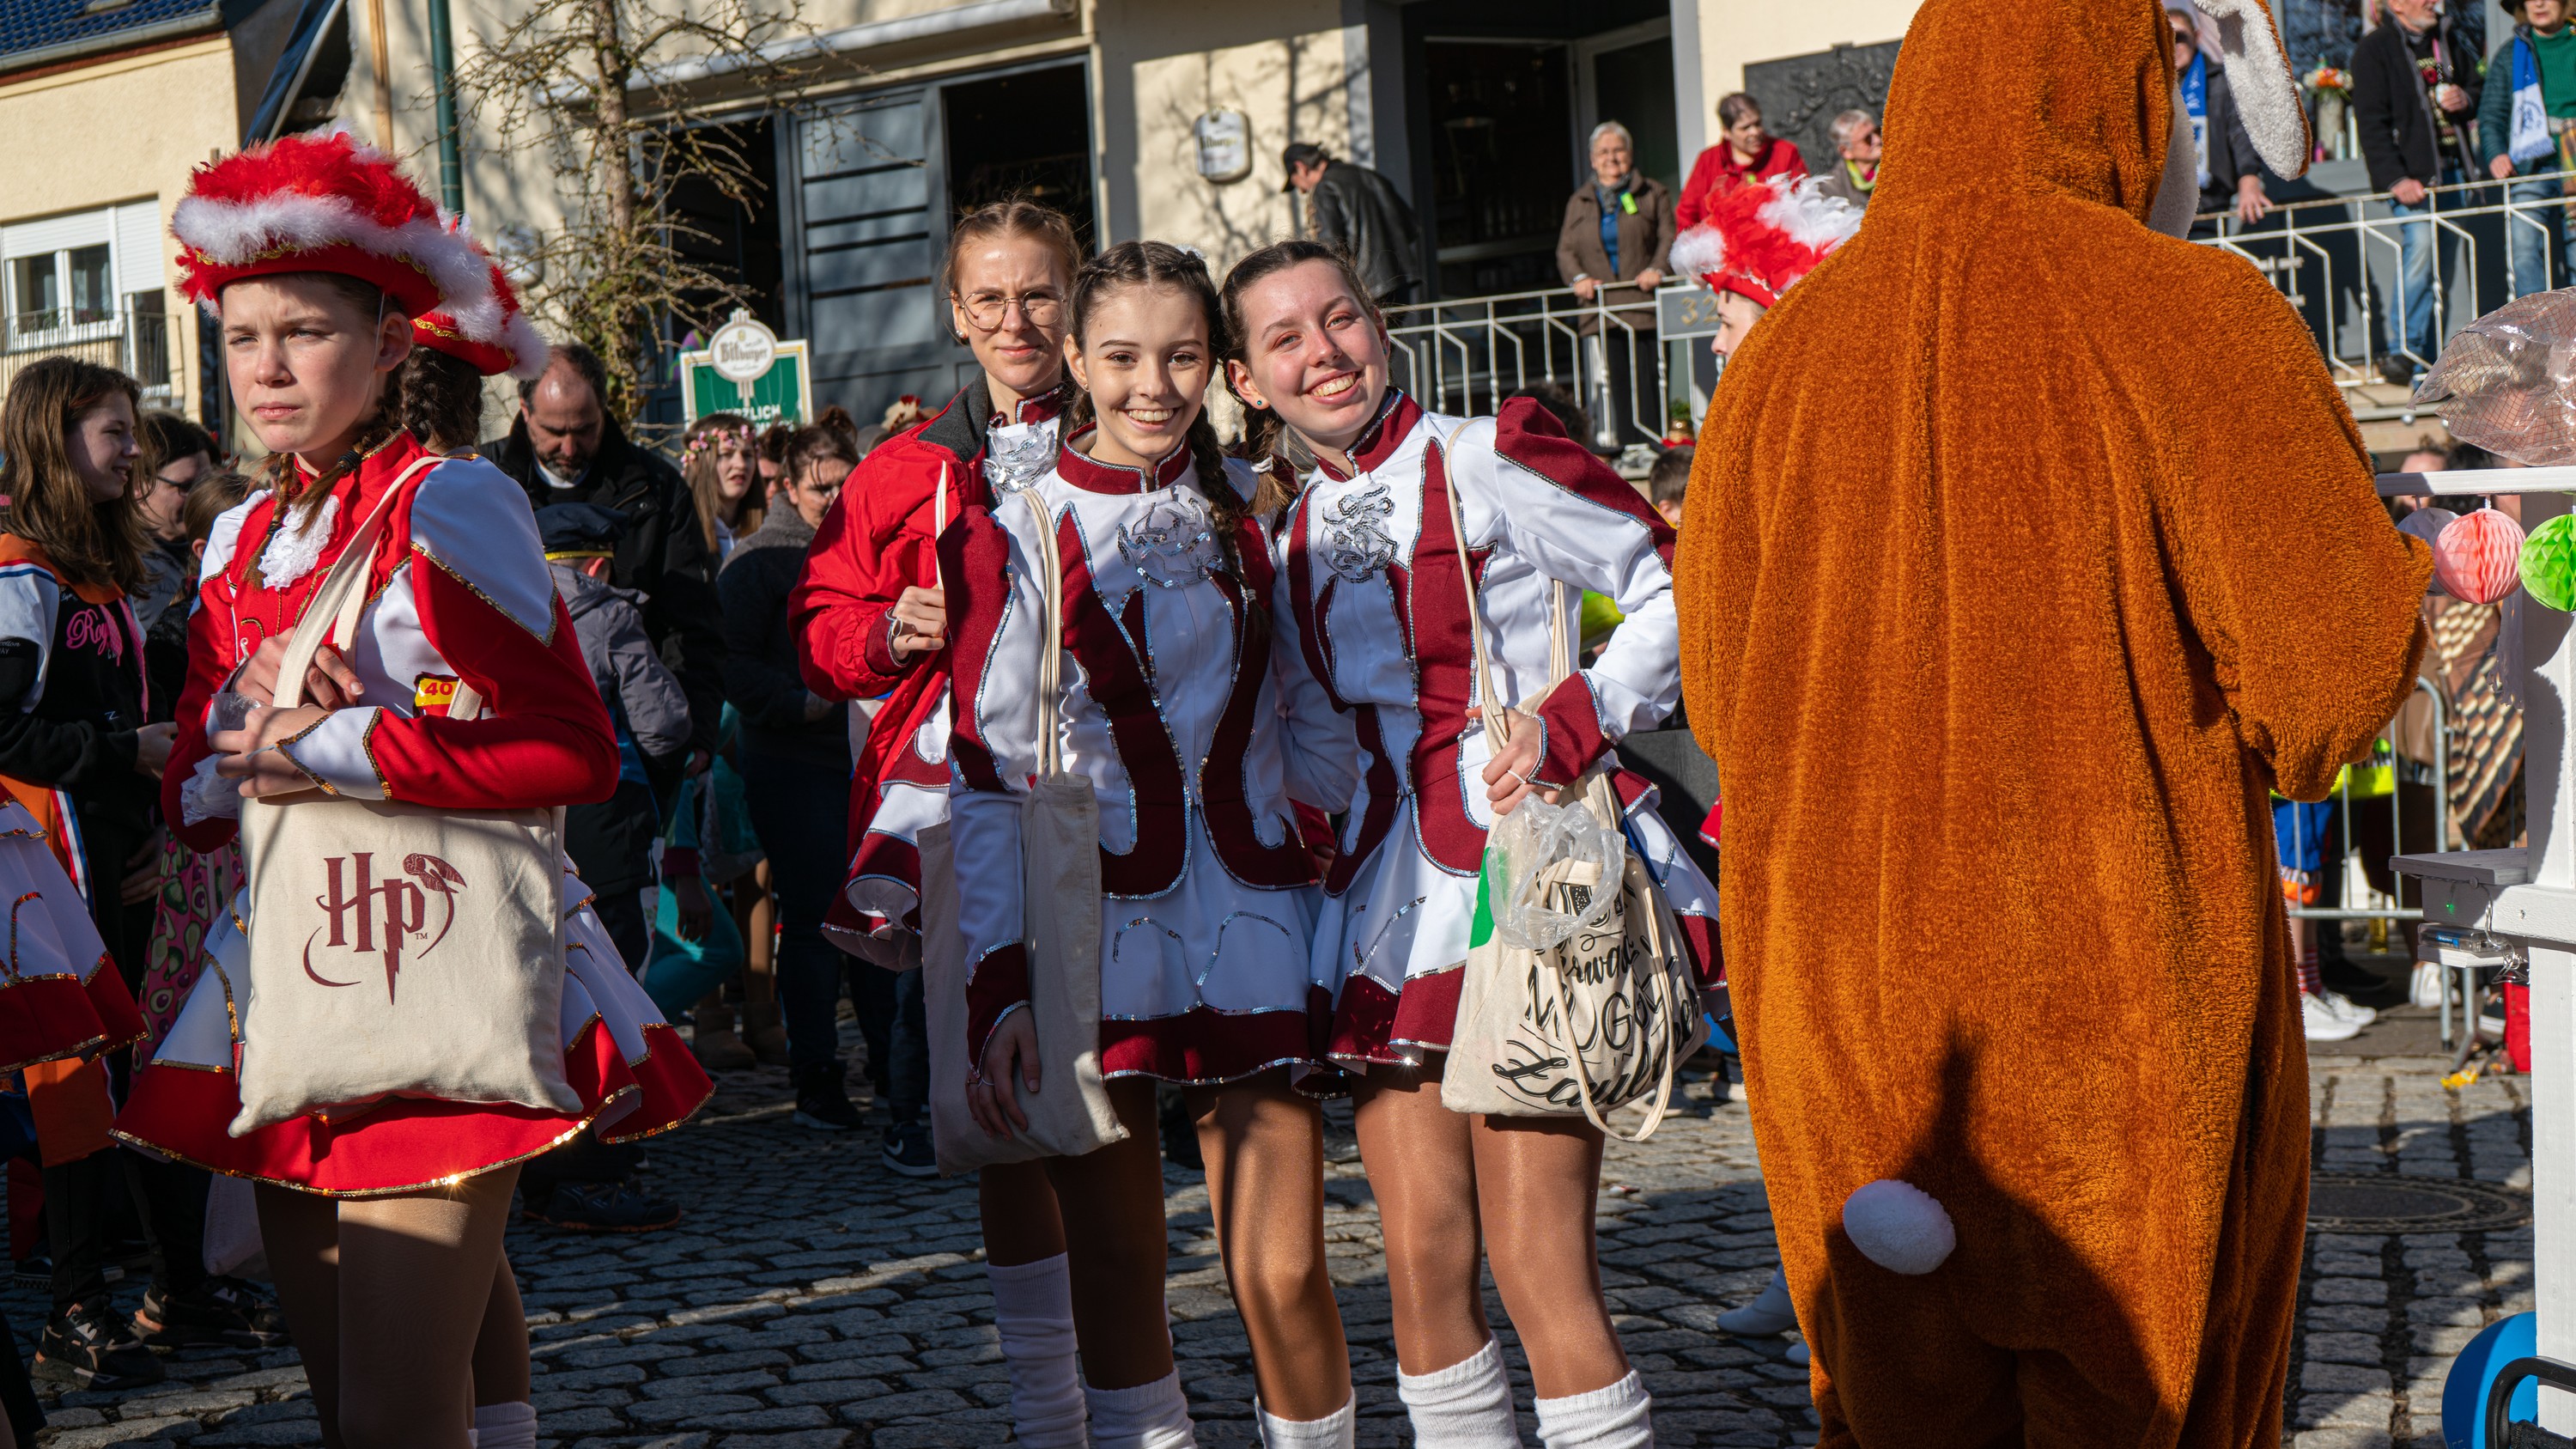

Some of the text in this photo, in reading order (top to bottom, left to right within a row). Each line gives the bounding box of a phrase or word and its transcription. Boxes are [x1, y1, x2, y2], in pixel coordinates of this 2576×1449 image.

[720, 342, 768, 362] Bitburger
[714, 404, 781, 421] RZLICH
[424, 682, 453, 696] 40
